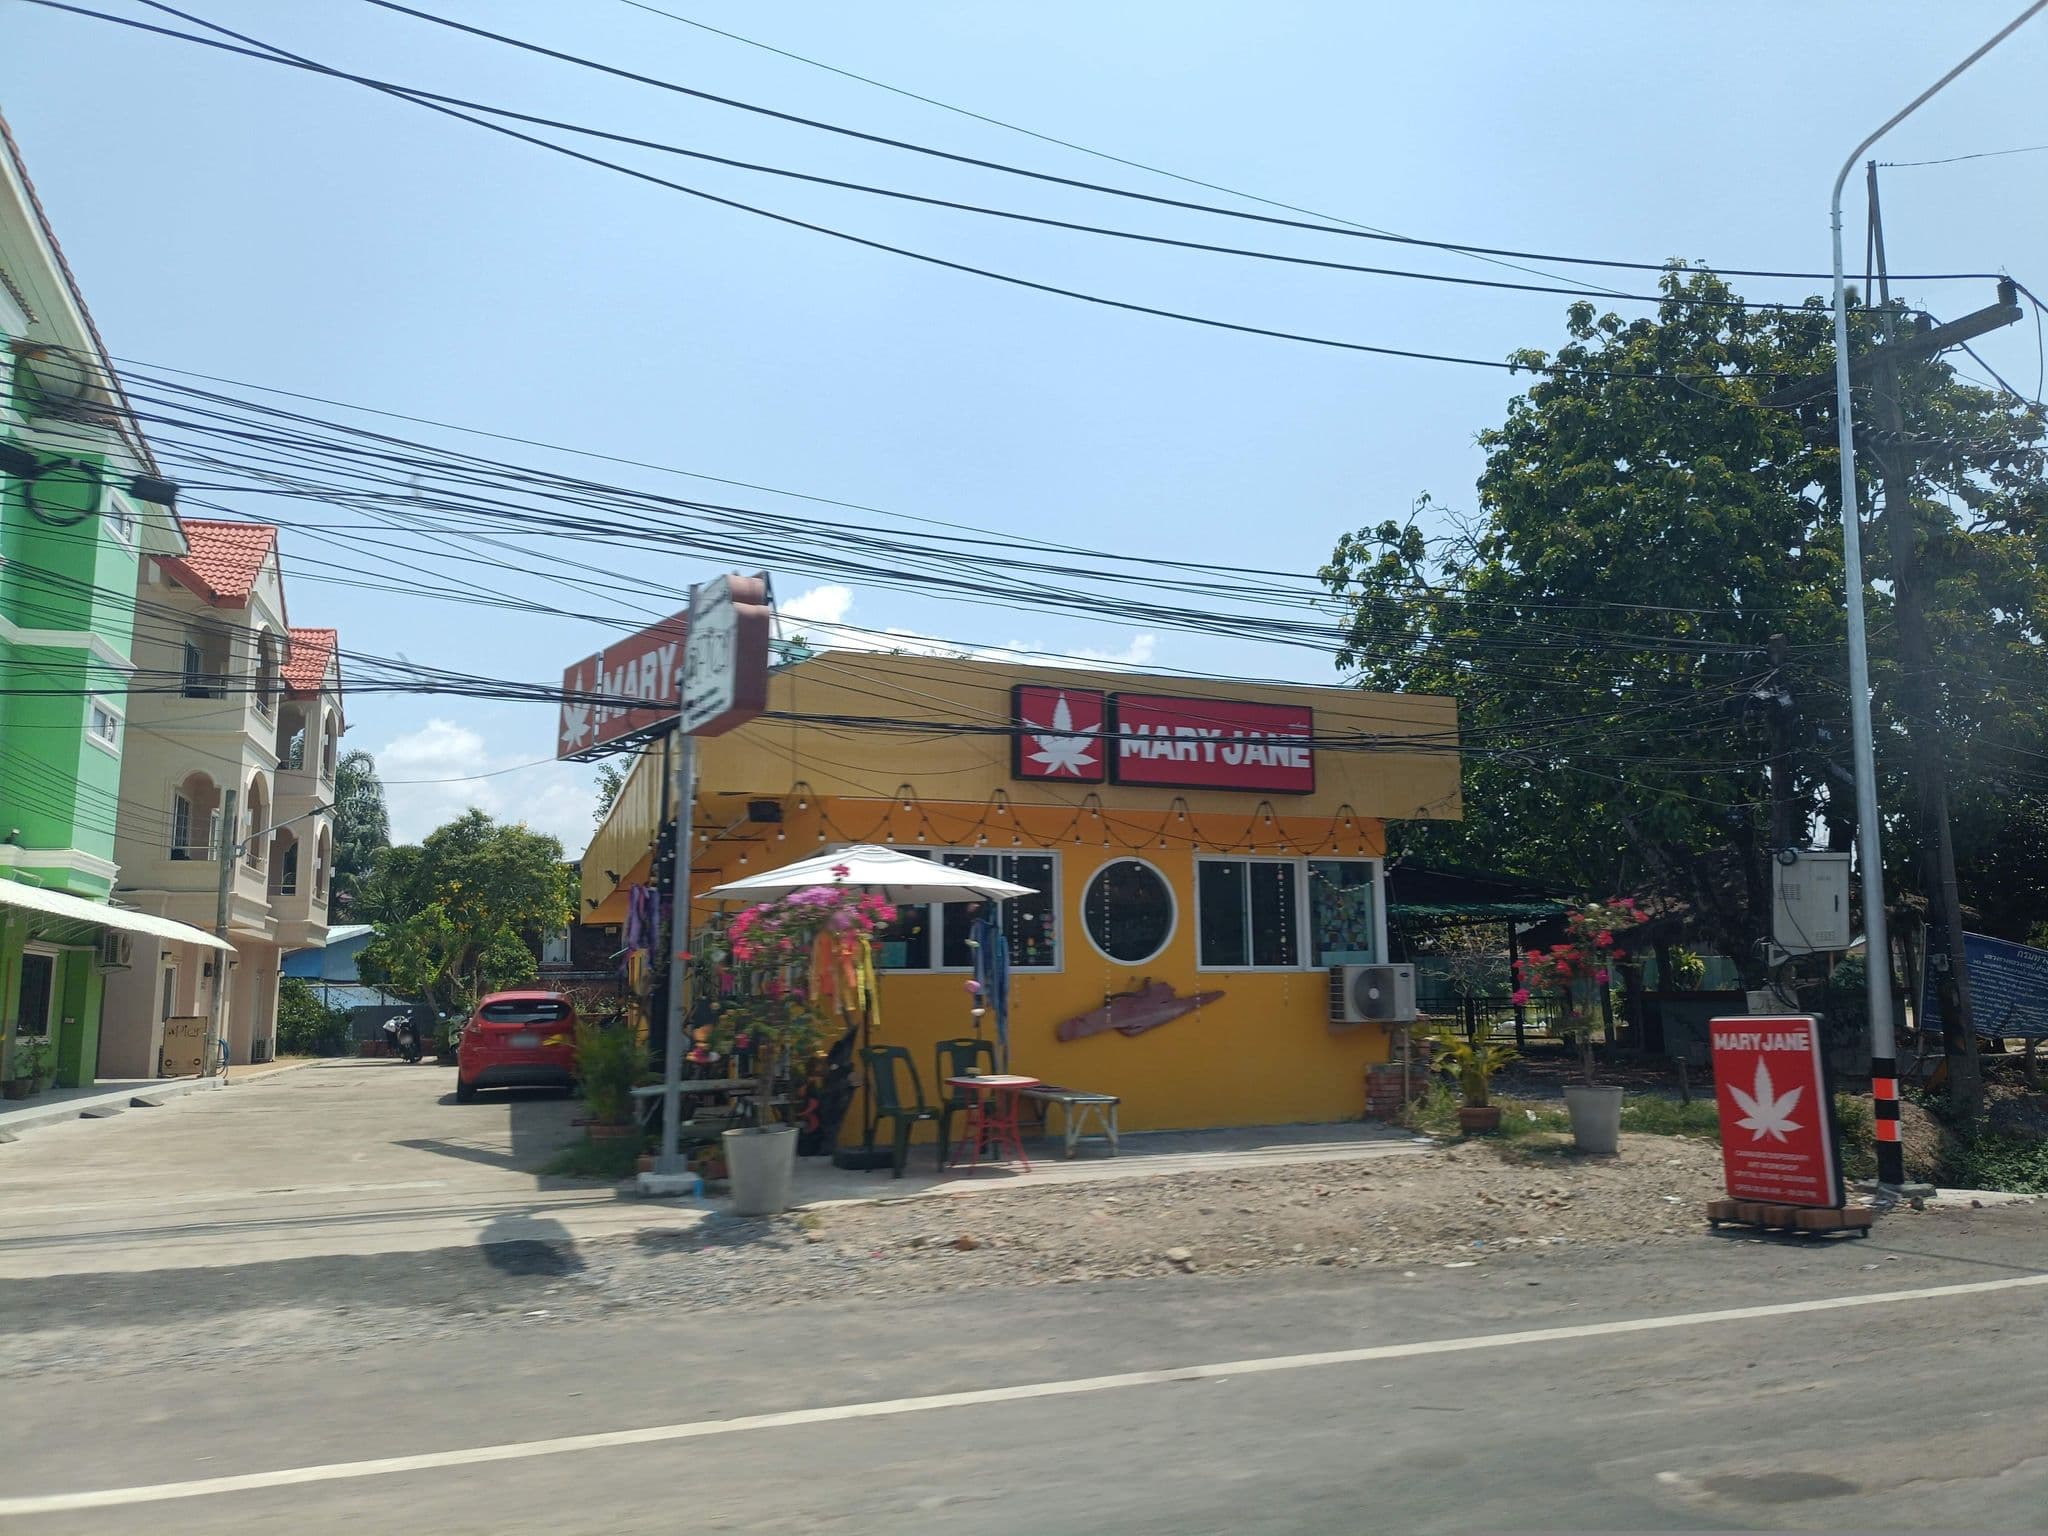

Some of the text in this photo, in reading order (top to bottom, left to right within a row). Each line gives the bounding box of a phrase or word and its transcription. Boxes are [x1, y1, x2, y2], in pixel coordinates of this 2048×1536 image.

[601, 641, 678, 723] MARY
[1119, 723, 1311, 768] MARY JANE
[1713, 1033, 1809, 1052] MARY JANE
